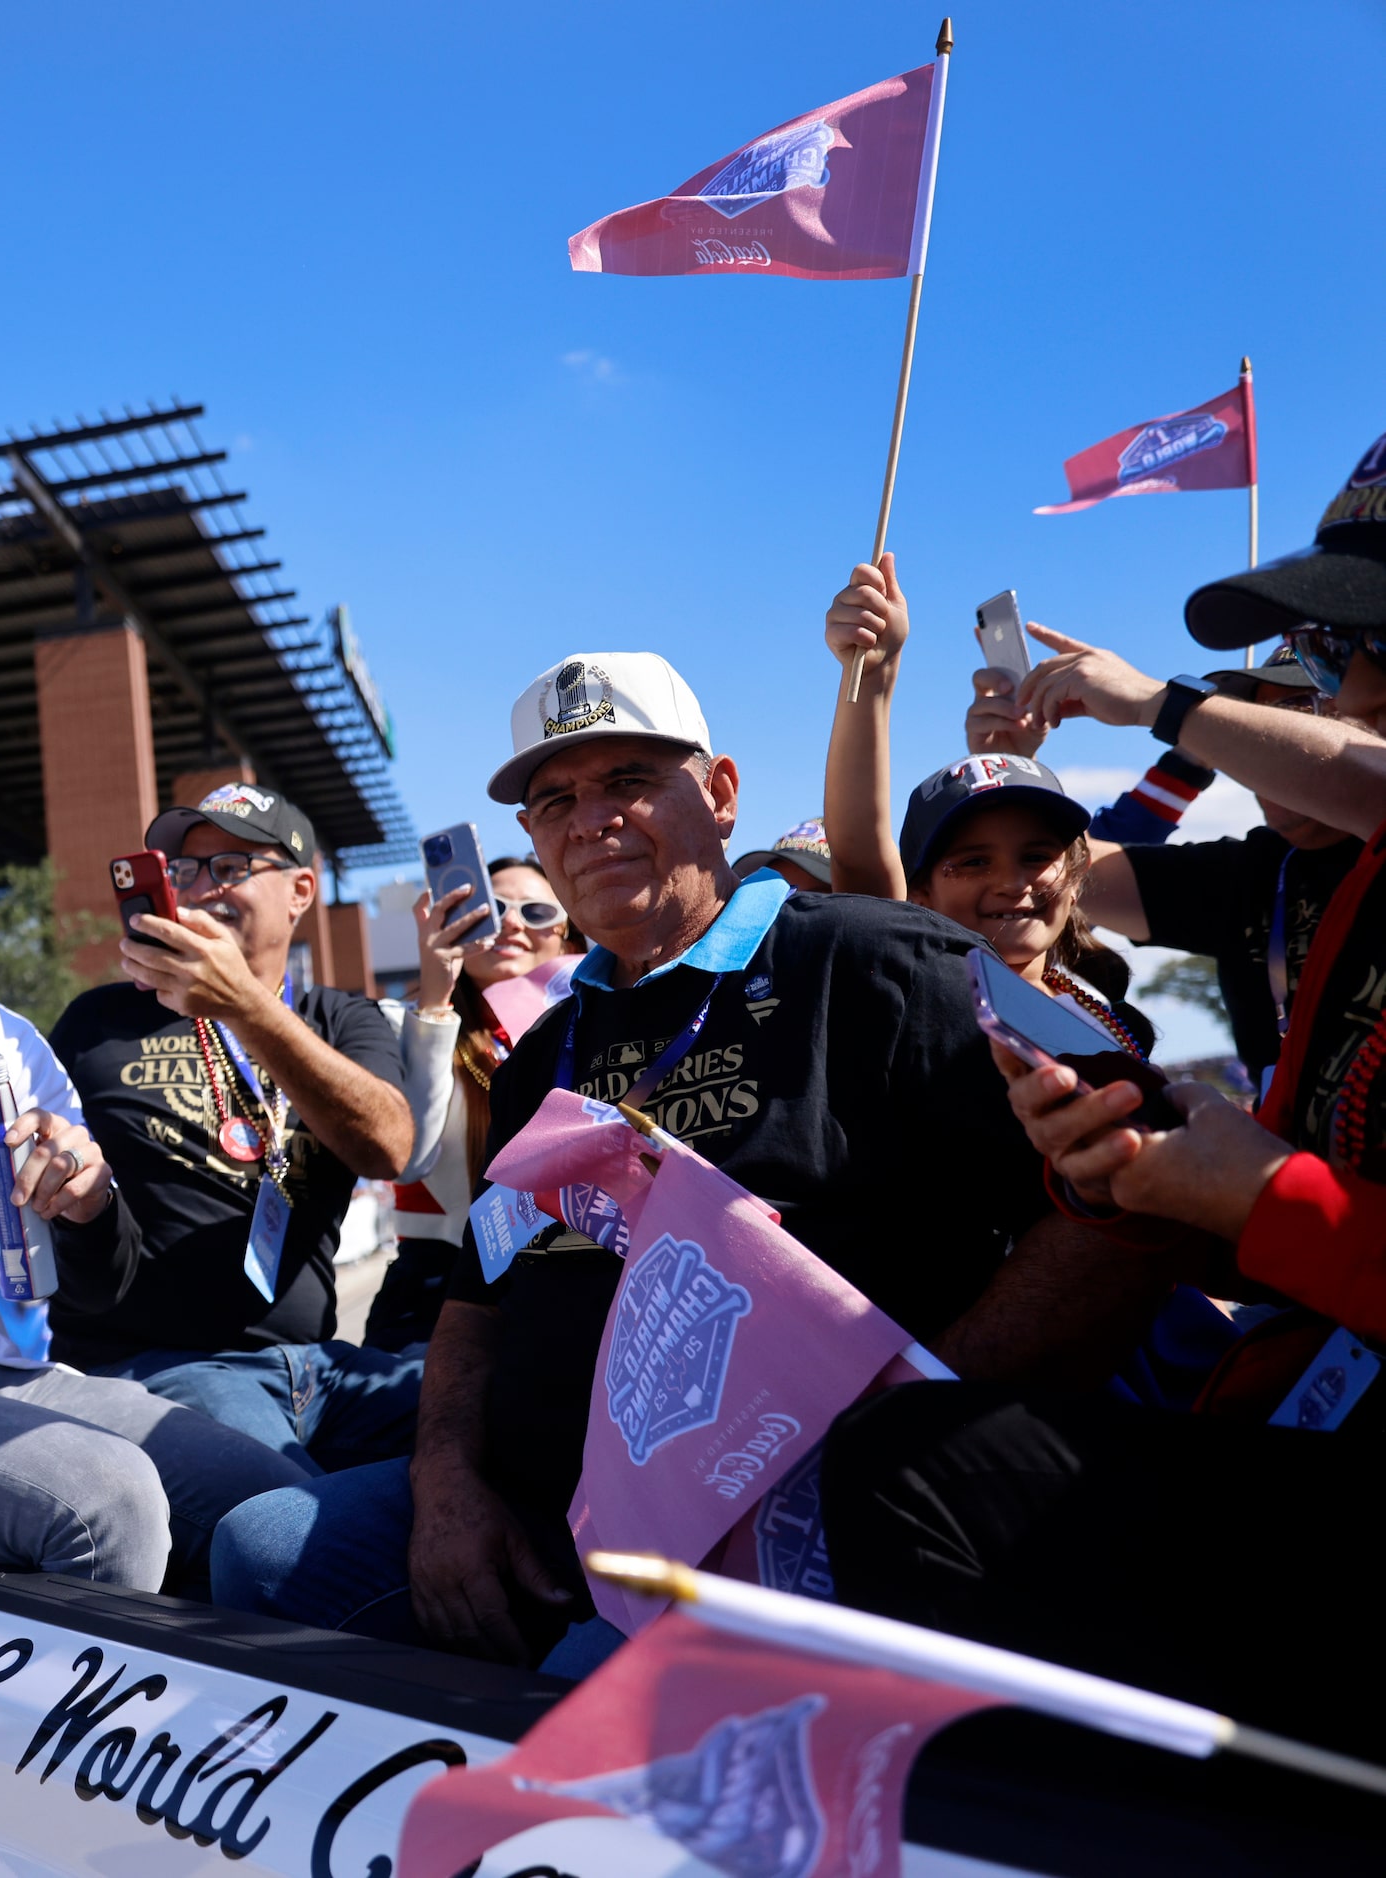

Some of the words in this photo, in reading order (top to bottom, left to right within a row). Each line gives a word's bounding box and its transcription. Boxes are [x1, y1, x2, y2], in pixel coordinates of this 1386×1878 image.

[545, 701, 612, 733] CHAMPIONS
[479, 1214, 495, 1261] FAMILY
[485, 1215, 495, 1238] VIP
[489, 1194, 514, 1258] PARADE
[15, 1647, 339, 1860] World
